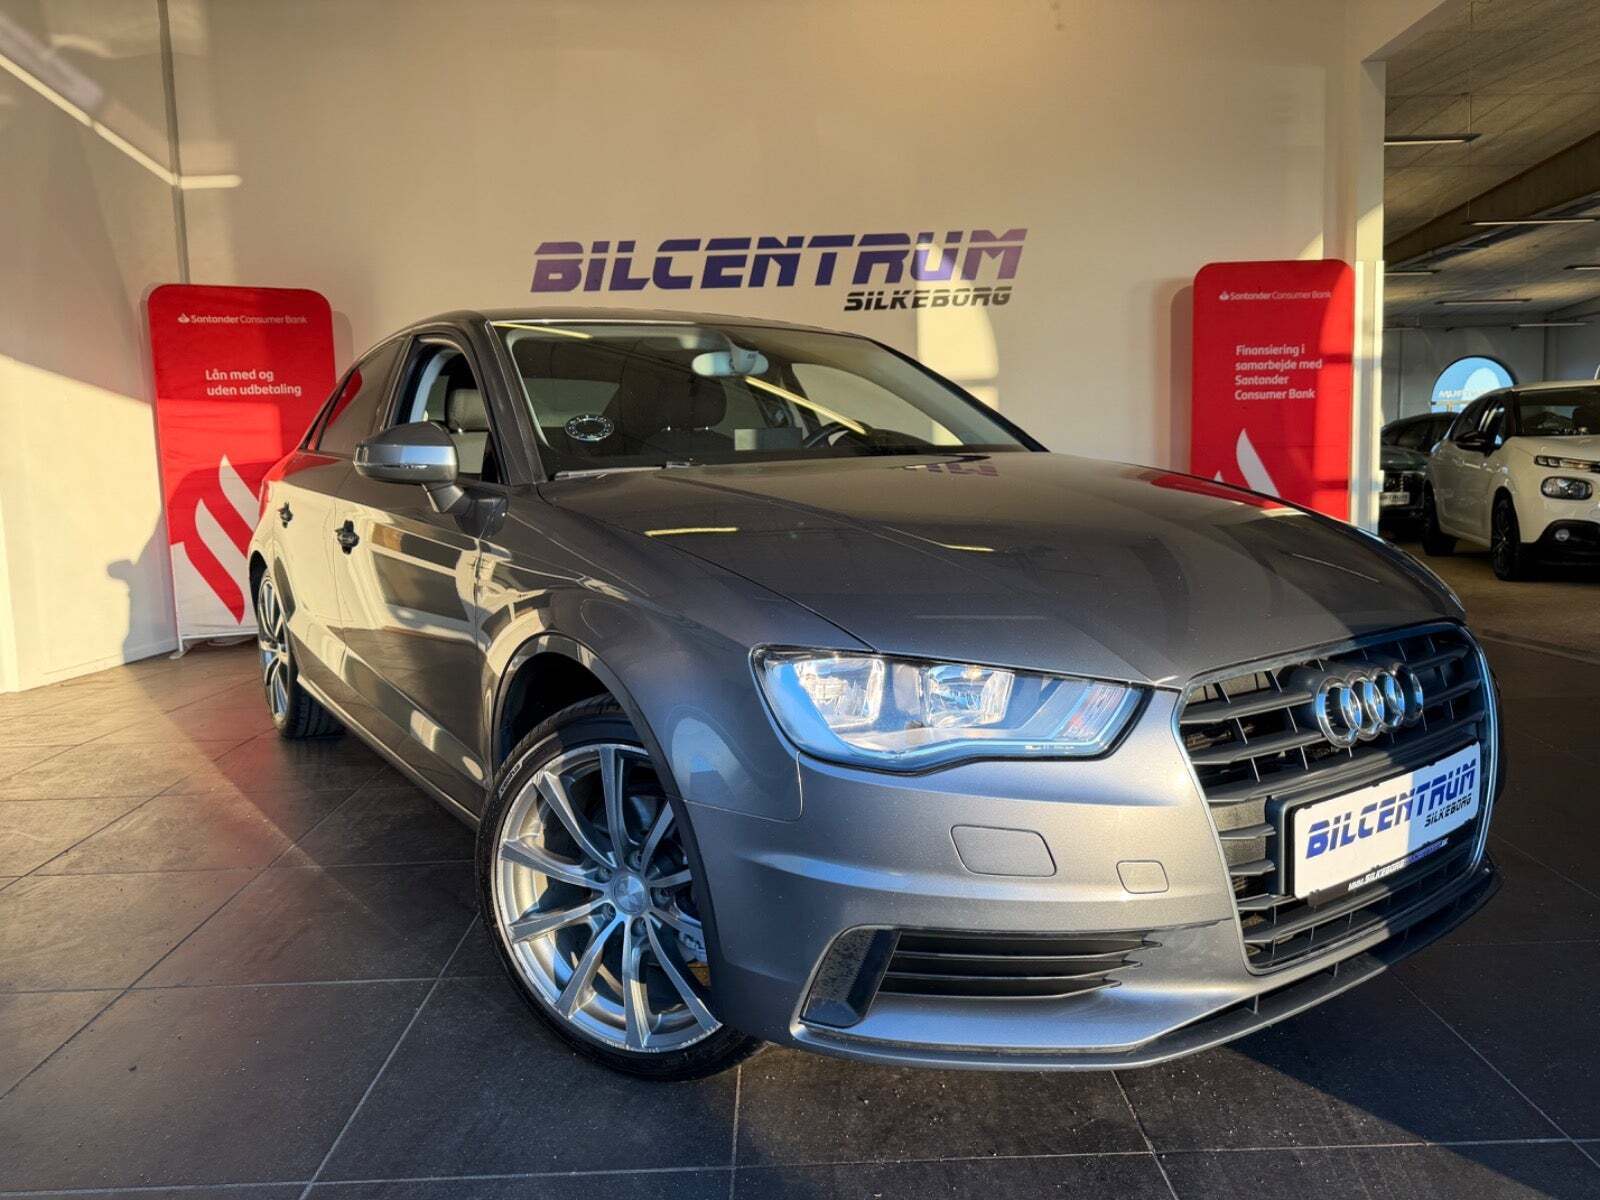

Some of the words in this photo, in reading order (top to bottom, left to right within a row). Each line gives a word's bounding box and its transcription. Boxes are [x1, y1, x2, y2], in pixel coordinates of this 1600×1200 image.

[530, 228, 1028, 292] BILCENTRUM
[843, 286, 1012, 311] SILKEBORG
[1230, 291, 1272, 301] Santander
[1272, 291, 1311, 300] Consumer
[1312, 290, 1332, 299] Bank
[191, 314, 239, 324] Santander
[239, 315, 284, 324] Consumer
[285, 315, 307, 324] Bank
[1236, 345, 1300, 357] Finansiering
[1235, 360, 1297, 372] samarbejde
[1299, 359, 1323, 369] med
[205, 368, 228, 381] Lån
[230, 369, 256, 381] med
[258, 371, 274, 382] og
[1235, 374, 1289, 386] Santander
[207, 384, 237, 396] uden
[239, 383, 302, 397] udbetaling
[1235, 389, 1287, 400] Consumer
[1288, 388, 1316, 399] Bank
[1305, 758, 1477, 860] BILCENTRUM
[1424, 793, 1472, 828] SILKEBORG
